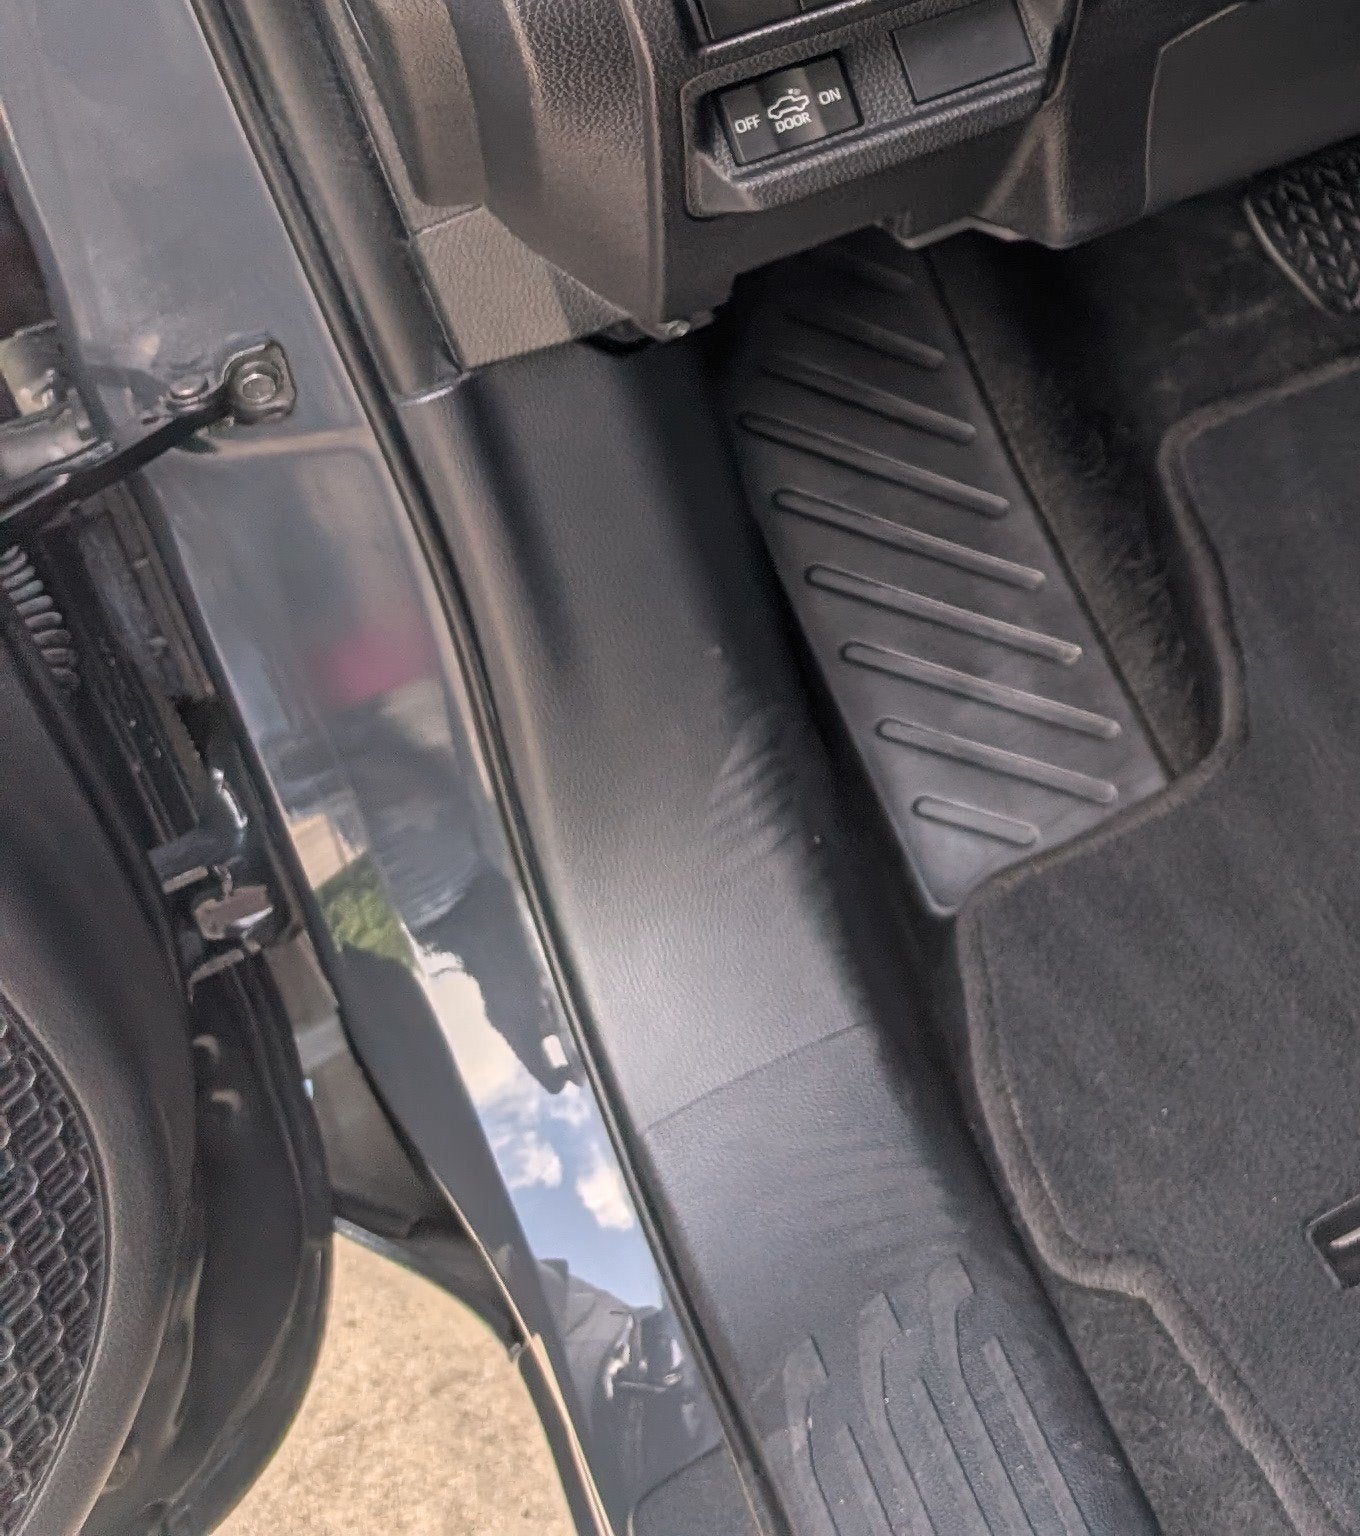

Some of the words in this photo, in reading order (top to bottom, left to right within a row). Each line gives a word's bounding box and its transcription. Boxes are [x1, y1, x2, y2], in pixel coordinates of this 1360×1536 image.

[734, 114, 761, 134] OFF
[818, 87, 842, 105] ON
[775, 112, 812, 134] DOOR
